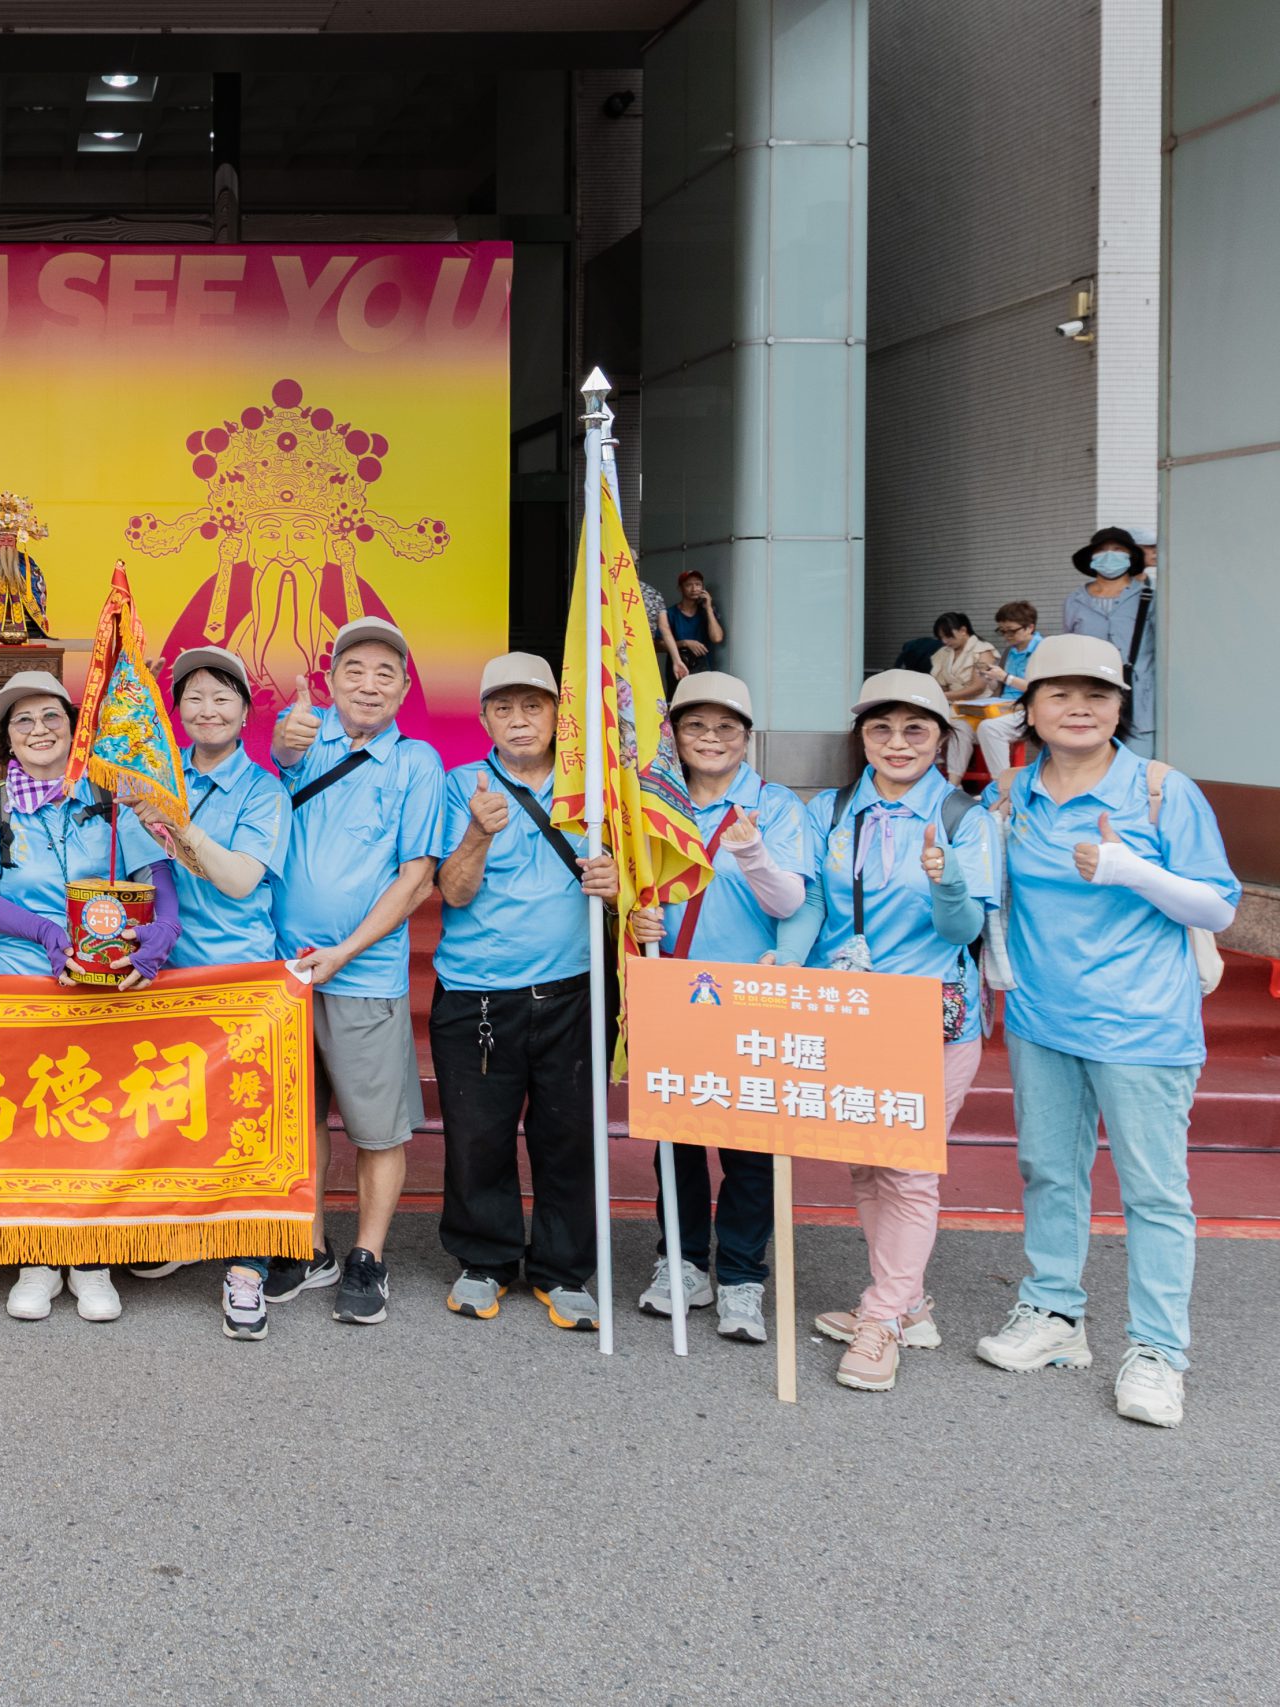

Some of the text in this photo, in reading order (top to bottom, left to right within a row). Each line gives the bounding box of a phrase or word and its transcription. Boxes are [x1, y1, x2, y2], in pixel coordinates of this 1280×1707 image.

[38, 252, 247, 345] SEE
[272, 254, 514, 353] YOU
[89, 914, 118, 928] 6-13
[732, 980, 787, 996] 2025
[790, 984, 869, 1005] 土地公
[735, 1029, 827, 1071] 中壢
[229, 1070, 266, 1110] 壢
[646, 1067, 926, 1130] 中央里福德祠
